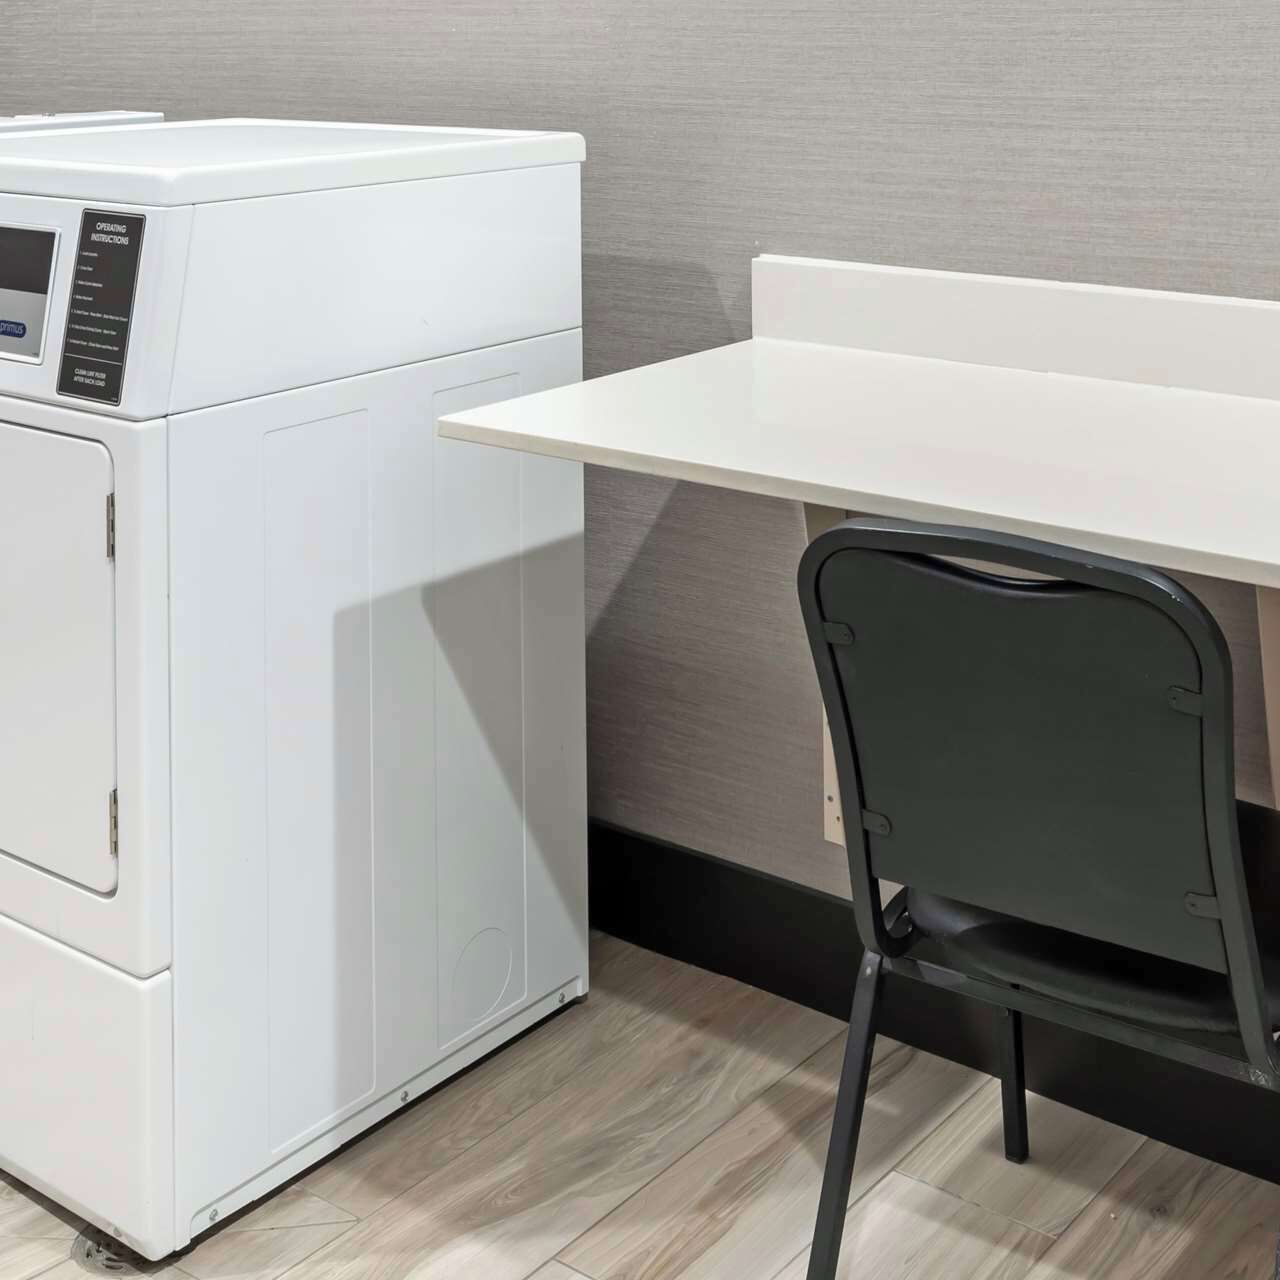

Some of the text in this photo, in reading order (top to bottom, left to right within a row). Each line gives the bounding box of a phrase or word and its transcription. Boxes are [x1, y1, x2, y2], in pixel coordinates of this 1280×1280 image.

[95, 221, 127, 233] OPERATING
[90, 232, 129, 246] INSTRUCTIONS
[0, 322, 24, 335] primus
